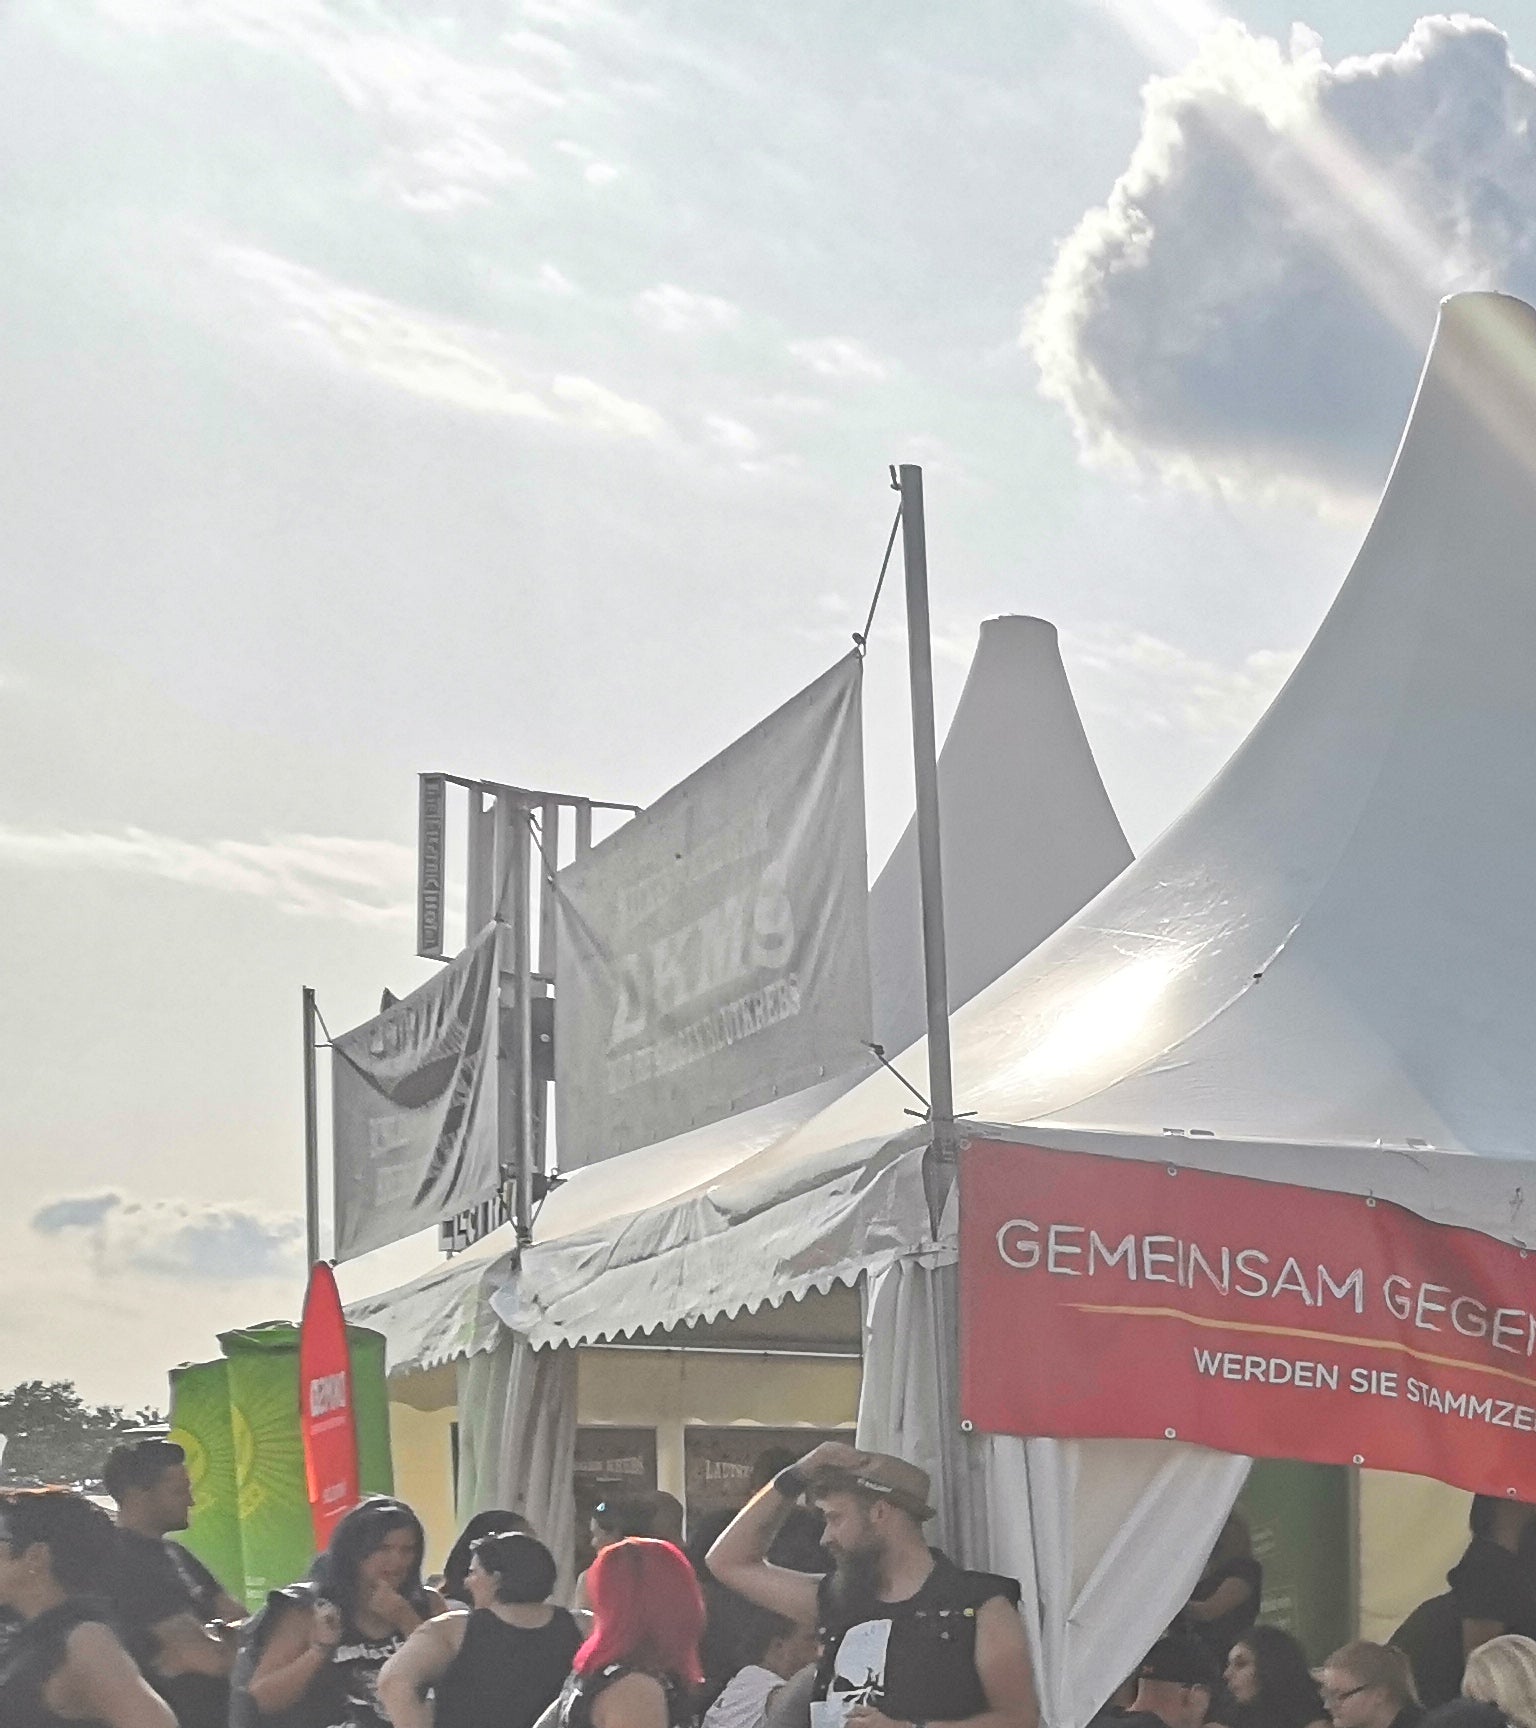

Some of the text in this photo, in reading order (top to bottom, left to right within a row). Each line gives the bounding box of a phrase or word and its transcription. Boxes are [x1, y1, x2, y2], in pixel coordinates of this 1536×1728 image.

[995, 1218, 1364, 1314] GEMEINSAM
[1193, 1346, 1339, 1391] WERDEN
[1350, 1367, 1398, 1398] SIE
